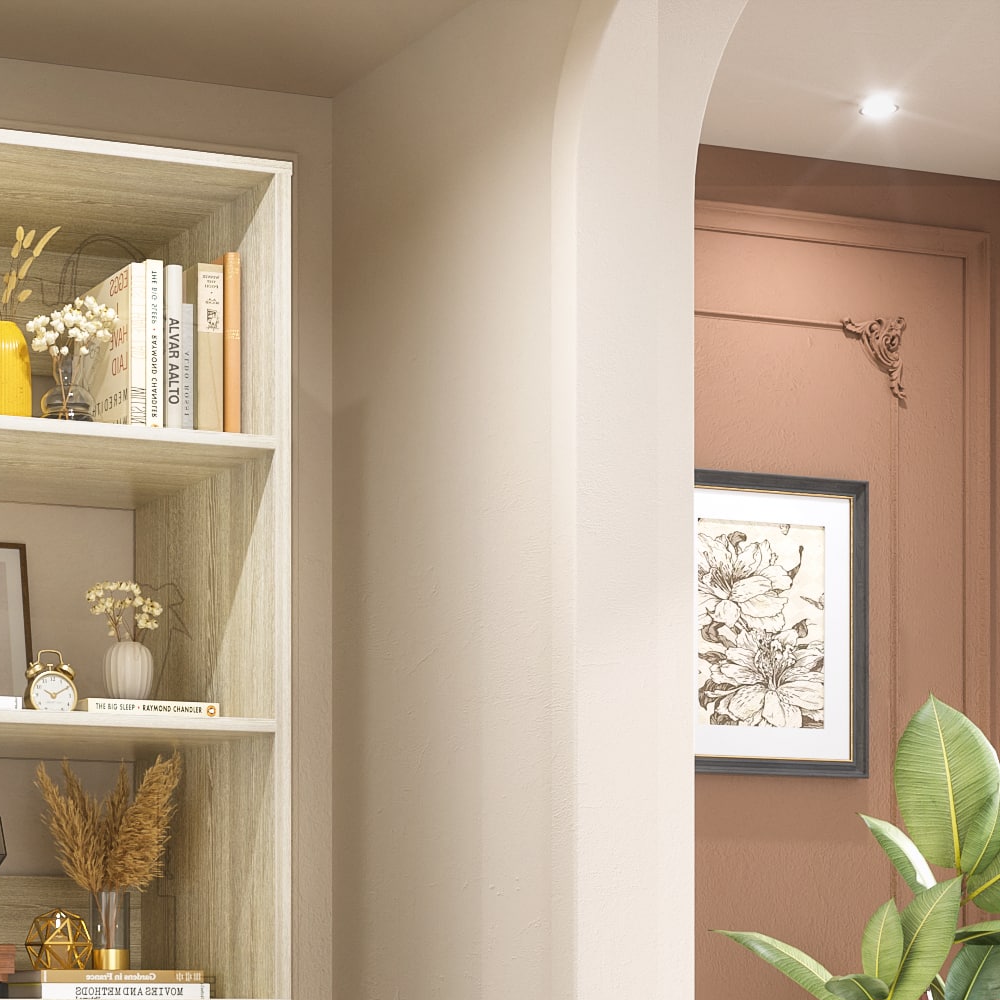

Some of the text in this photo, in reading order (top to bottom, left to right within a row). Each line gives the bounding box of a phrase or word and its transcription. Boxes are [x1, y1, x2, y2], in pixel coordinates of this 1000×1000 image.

[169, 317, 180, 405] ALVAR AALTO
[95, 702, 106, 710] THE
[119, 703, 136, 711] SLEEP
[142, 704, 172, 712] RAYMOND
[173, 705, 203, 714] CHANDLER
